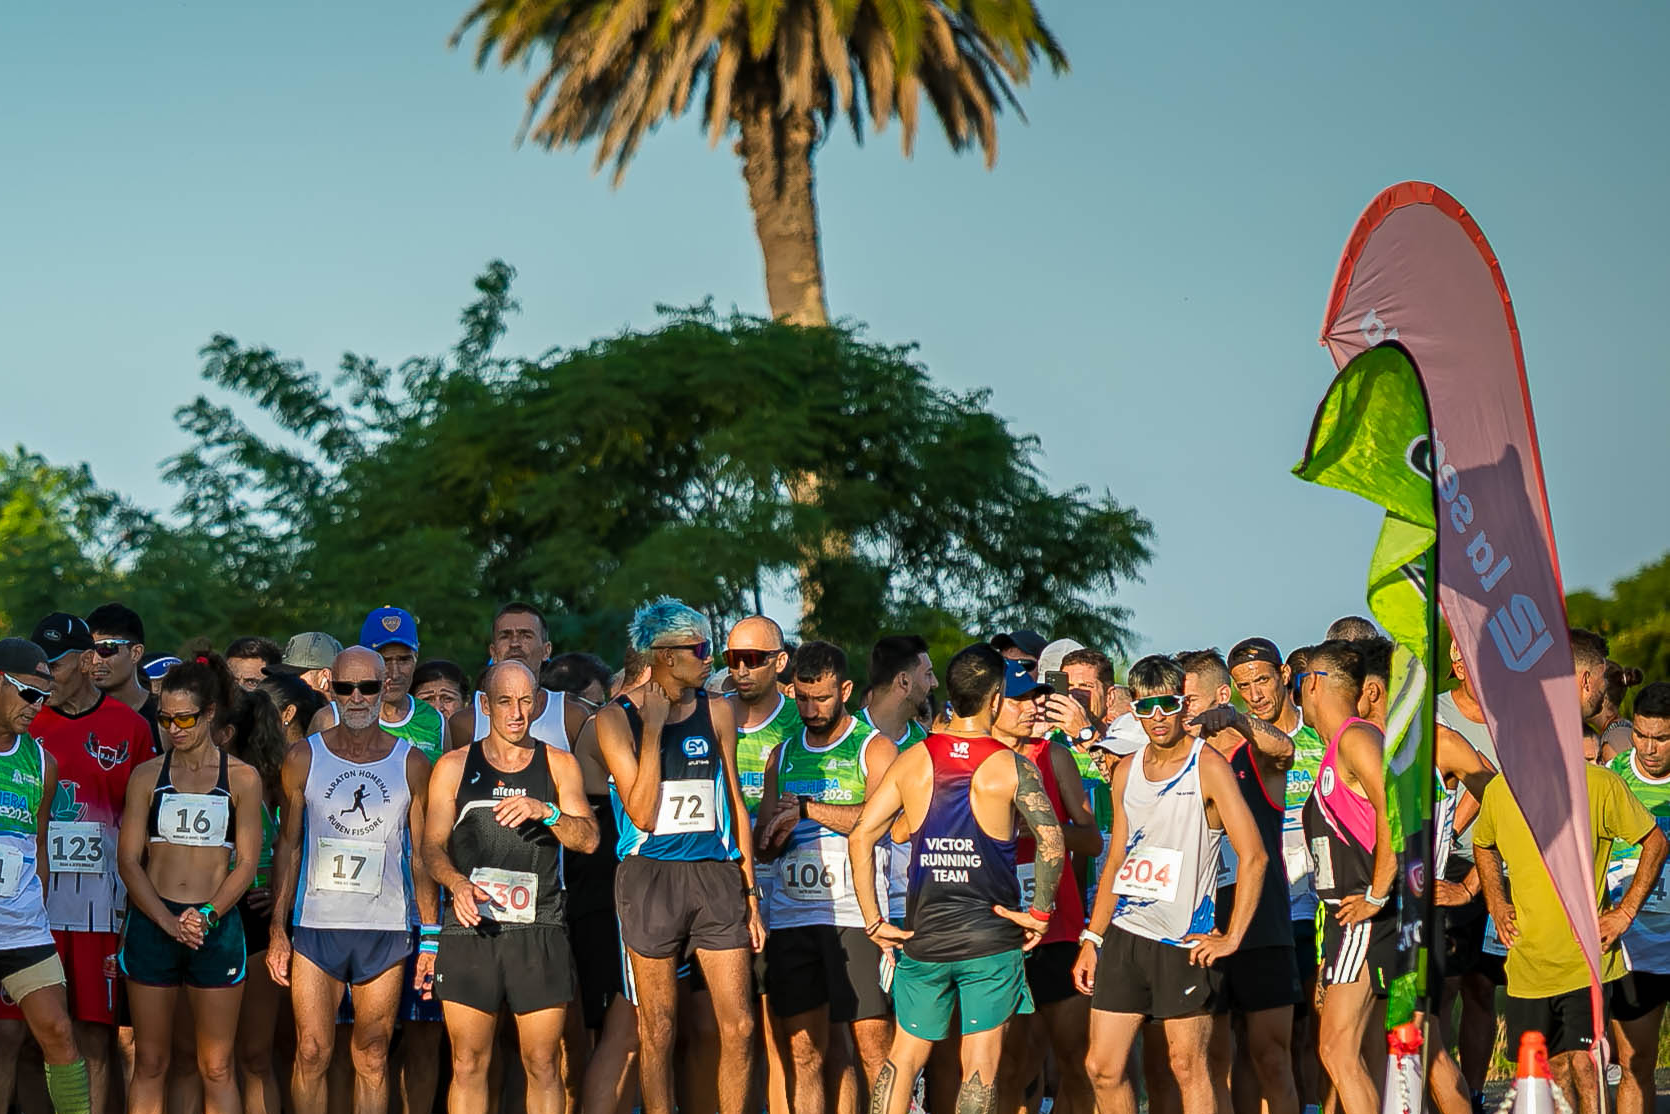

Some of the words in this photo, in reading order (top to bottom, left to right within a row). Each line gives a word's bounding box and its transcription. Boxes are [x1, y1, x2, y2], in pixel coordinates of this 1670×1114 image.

[324, 769, 356, 800] MARATON
[359, 769, 391, 804] HOMENAJE
[492, 786, 527, 797] ATENAS
[669, 795, 705, 820] 72
[176, 808, 211, 834] 16
[327, 814, 351, 836] RUBEN
[352, 815, 384, 836] FISSORE
[51, 835, 104, 862] 123
[925, 837, 975, 852] VICTOR
[332, 854, 367, 880] 17
[920, 853, 982, 868] RUNNING
[1119, 859, 1172, 887] 504
[786, 862, 836, 889] 106
[932, 869, 969, 883] TEAM
